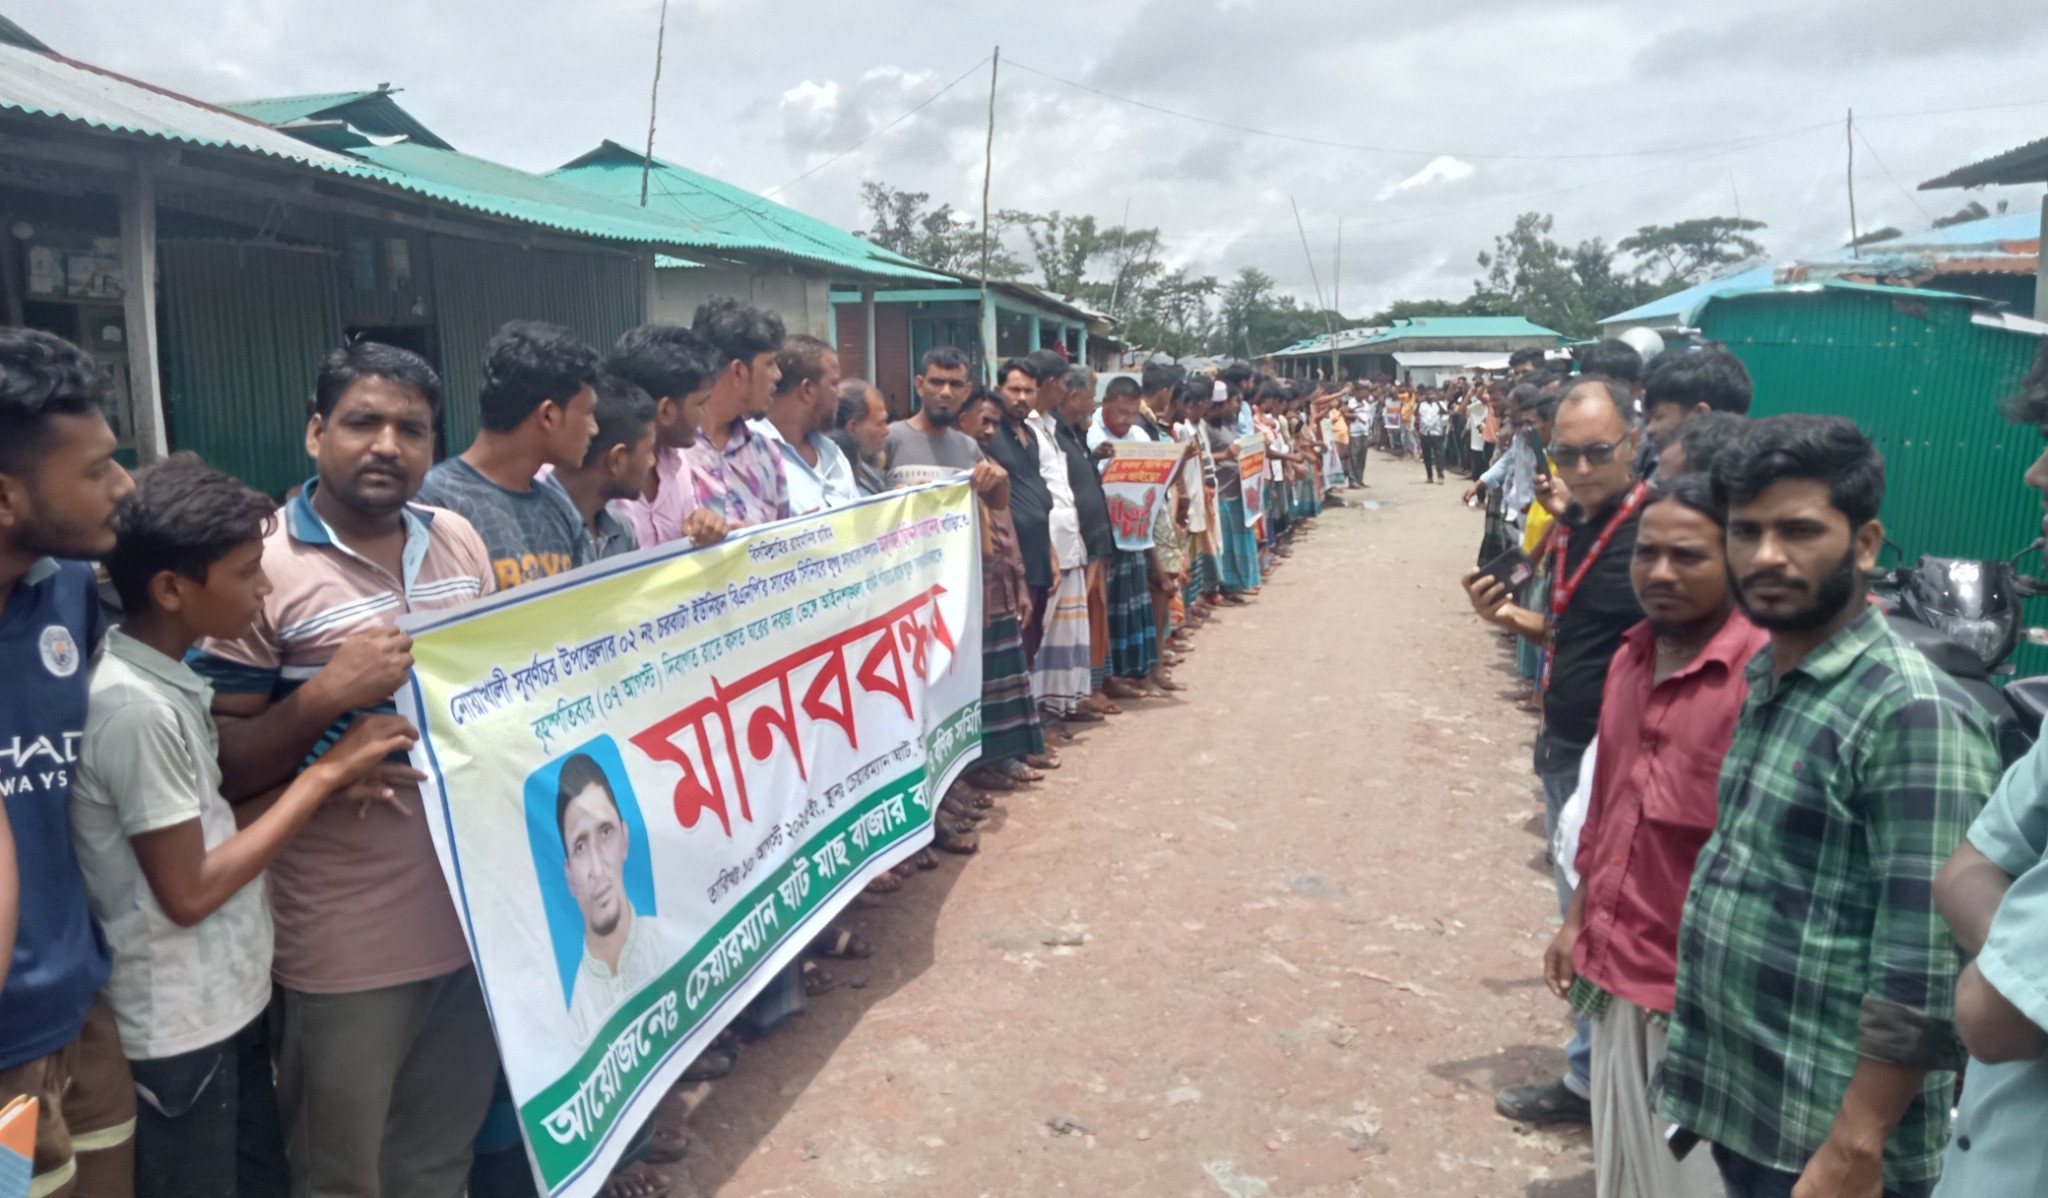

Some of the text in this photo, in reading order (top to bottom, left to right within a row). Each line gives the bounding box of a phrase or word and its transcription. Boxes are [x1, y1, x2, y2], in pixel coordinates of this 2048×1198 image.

[451, 667, 514, 726] নোয়াখালী
[557, 634, 617, 677] উপজেলার
[619, 630, 639, 654] ০২
[640, 623, 655, 645] নং
[692, 593, 727, 625] ইউনিয়ন
[530, 694, 597, 755] বৃহস্পতিবার
[700, 637, 723, 663] রাতে
[756, 825, 783, 862] আগস্ট
[846, 755, 891, 794] চেয়ারম্যান
[539, 989, 680, 1147] আয়োজনেঃ
[685, 892, 780, 1012] চেয়ারম্যান
[777, 855, 811, 912] ঘাট
[812, 832, 851, 880] মাছ
[848, 791, 907, 852] বাজার
